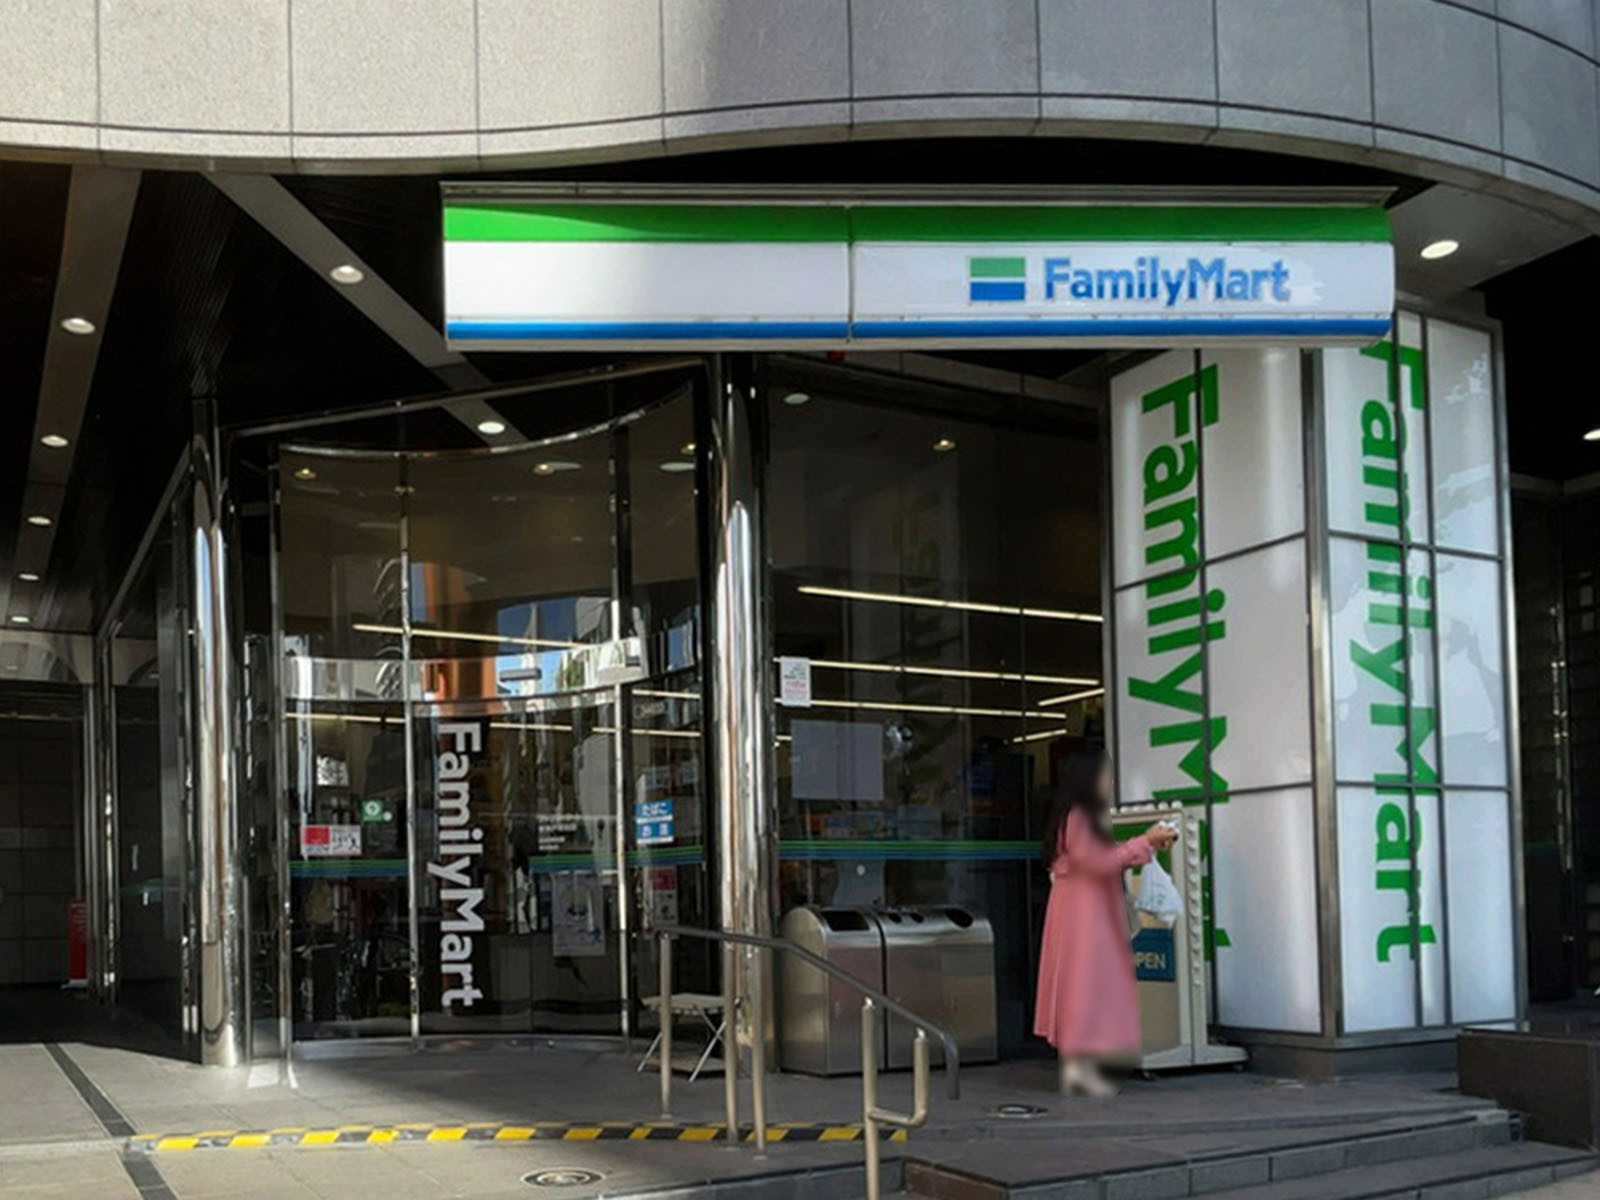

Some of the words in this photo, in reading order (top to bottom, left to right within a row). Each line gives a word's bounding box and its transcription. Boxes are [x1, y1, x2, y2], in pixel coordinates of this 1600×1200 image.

[1044, 257, 1291, 306] FamilyMart
[1128, 363, 1231, 962] FamilyM
[428, 722, 485, 1008] FamilyMart
[1135, 952, 1167, 970] PEN
